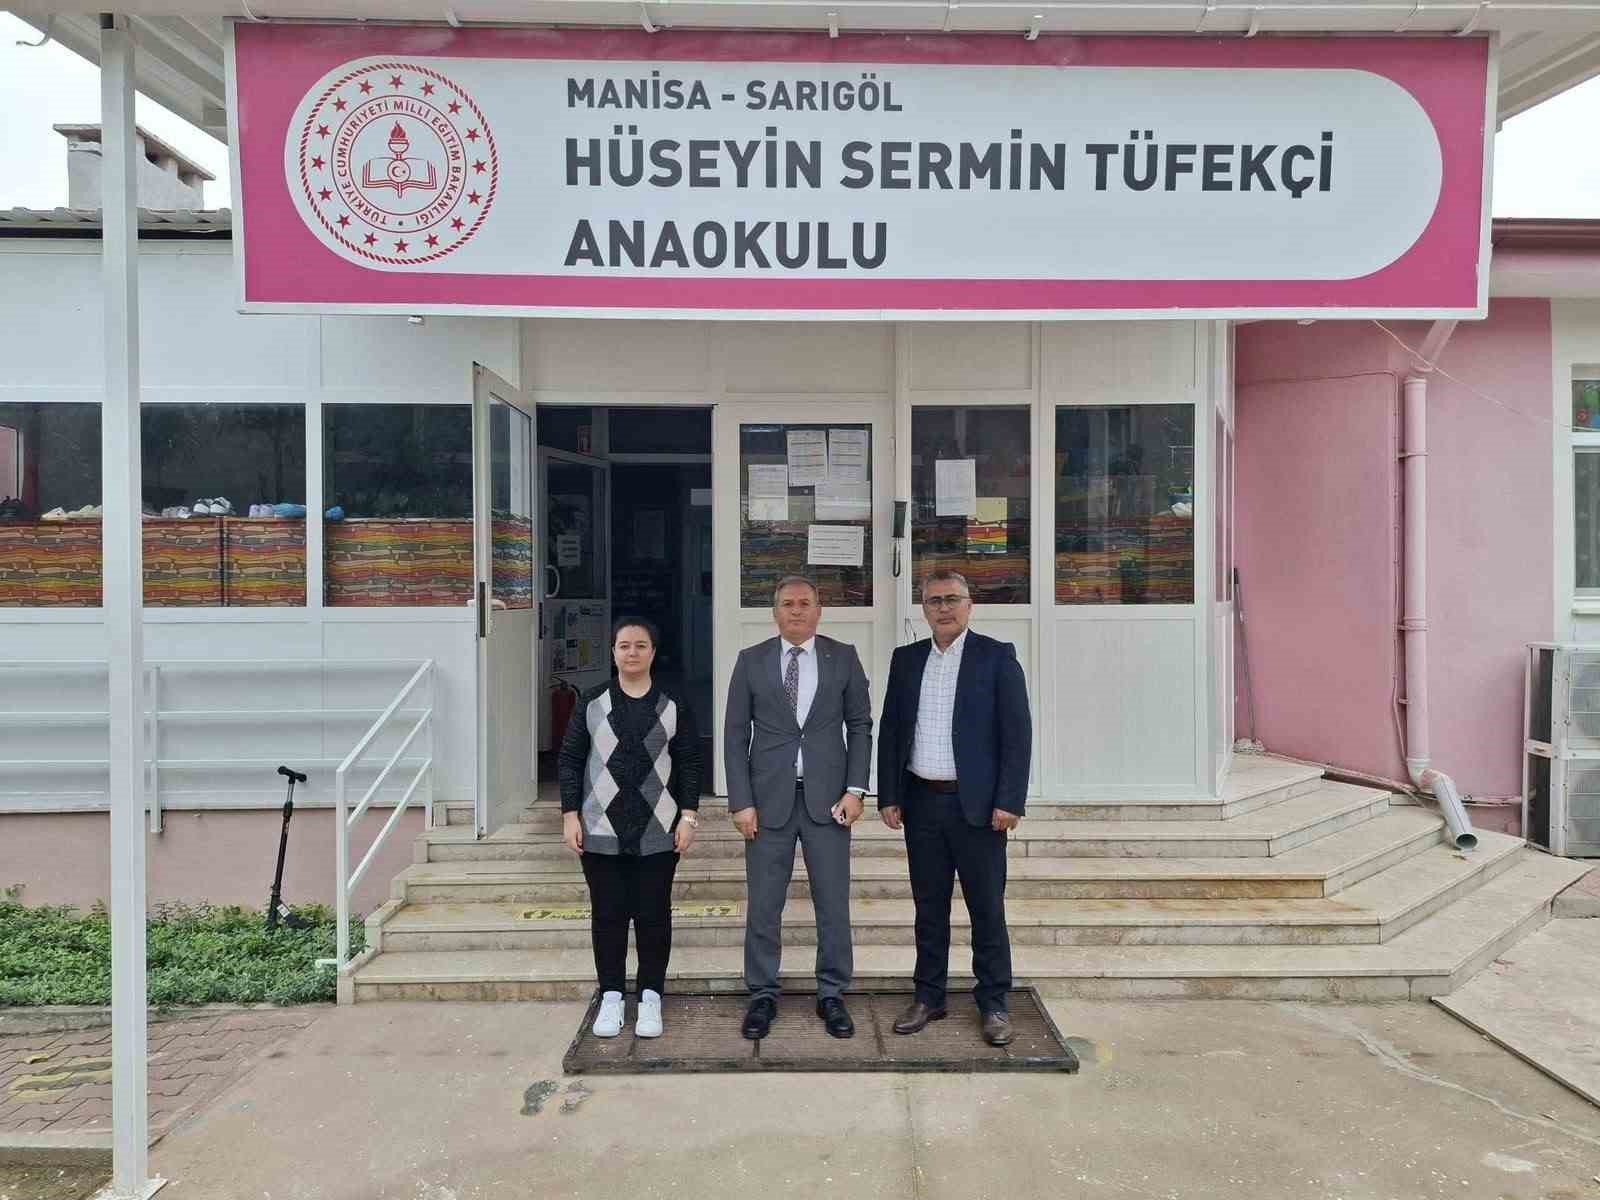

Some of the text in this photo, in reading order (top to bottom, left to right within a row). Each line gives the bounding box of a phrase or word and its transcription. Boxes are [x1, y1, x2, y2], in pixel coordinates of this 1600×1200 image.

[567, 70, 903, 112] MANİSA - SARIGÖL
[565, 124, 1334, 199] HÜSEYİN SERMİN TÜFEKÇİ
[563, 218, 888, 270] ANAOKULU
